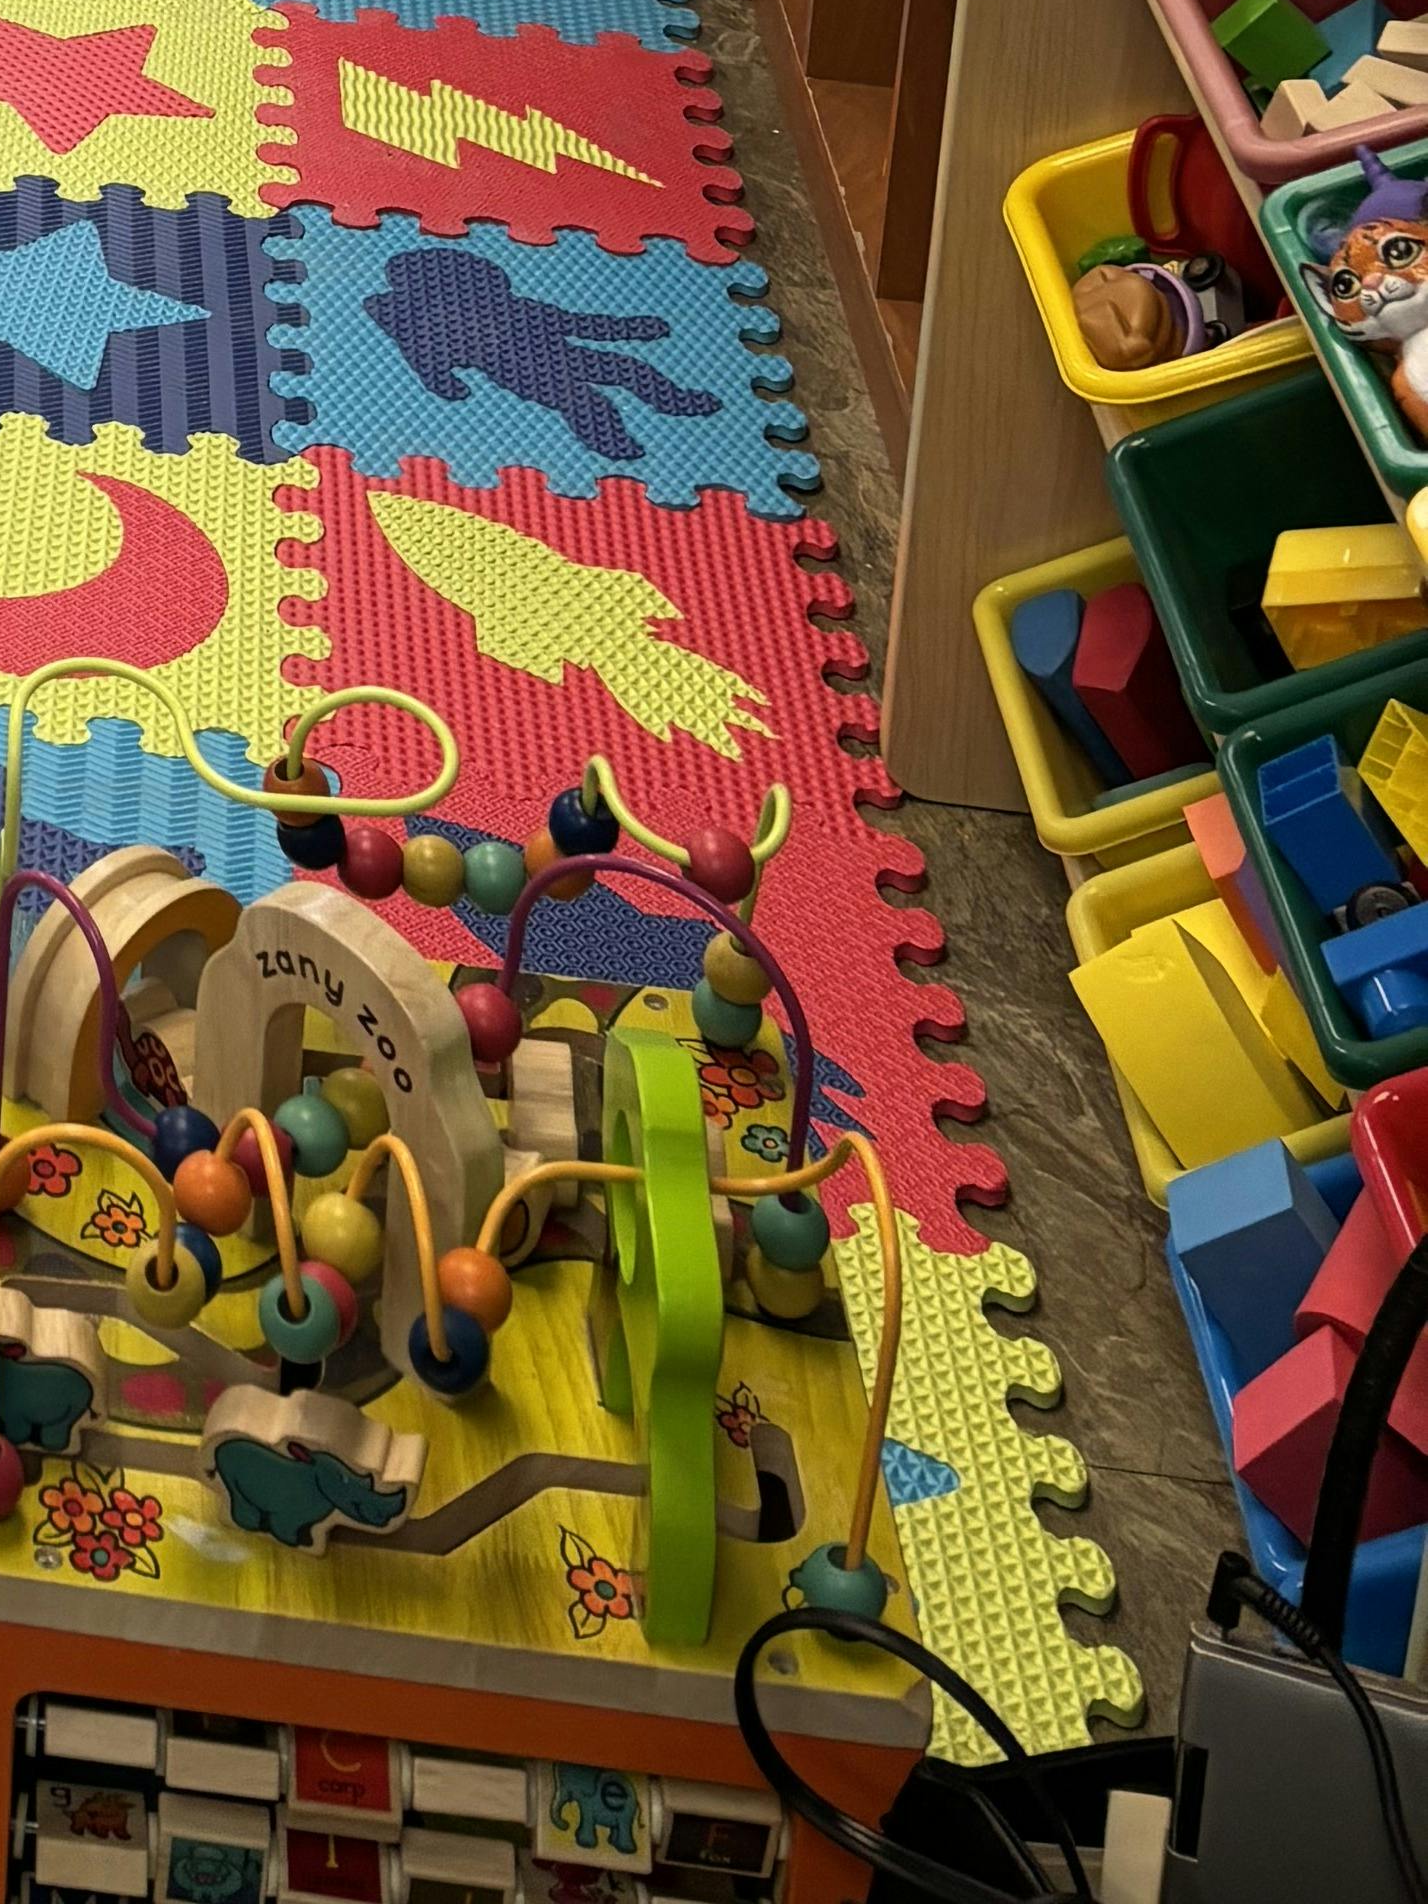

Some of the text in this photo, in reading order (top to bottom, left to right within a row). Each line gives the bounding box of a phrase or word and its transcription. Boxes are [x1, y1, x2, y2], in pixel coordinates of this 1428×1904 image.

[255, 949, 413, 1093] zany zoo
[317, 1779, 366, 1805] carp
[600, 1780, 628, 1812] e
